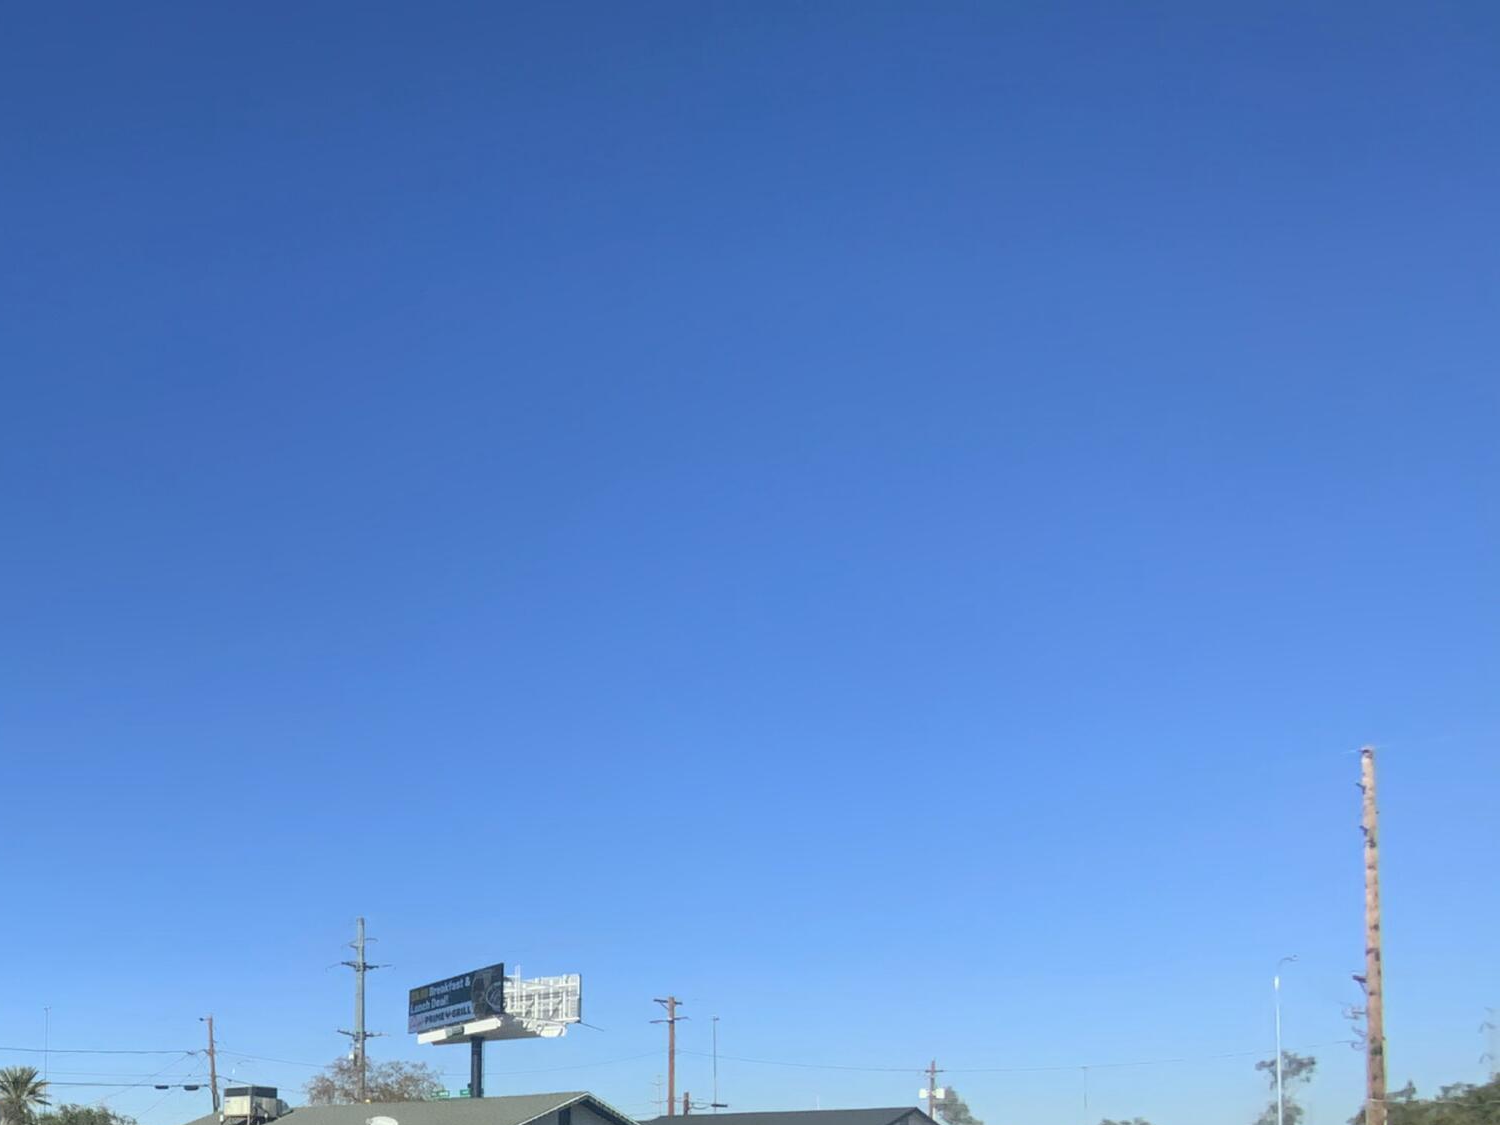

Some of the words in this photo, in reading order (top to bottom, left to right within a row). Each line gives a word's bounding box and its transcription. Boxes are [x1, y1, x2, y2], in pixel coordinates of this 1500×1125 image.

[429, 979, 464, 996] Breakfast
[425, 1012, 444, 1024] PRIME
[452, 1006, 471, 1017] GRILL
